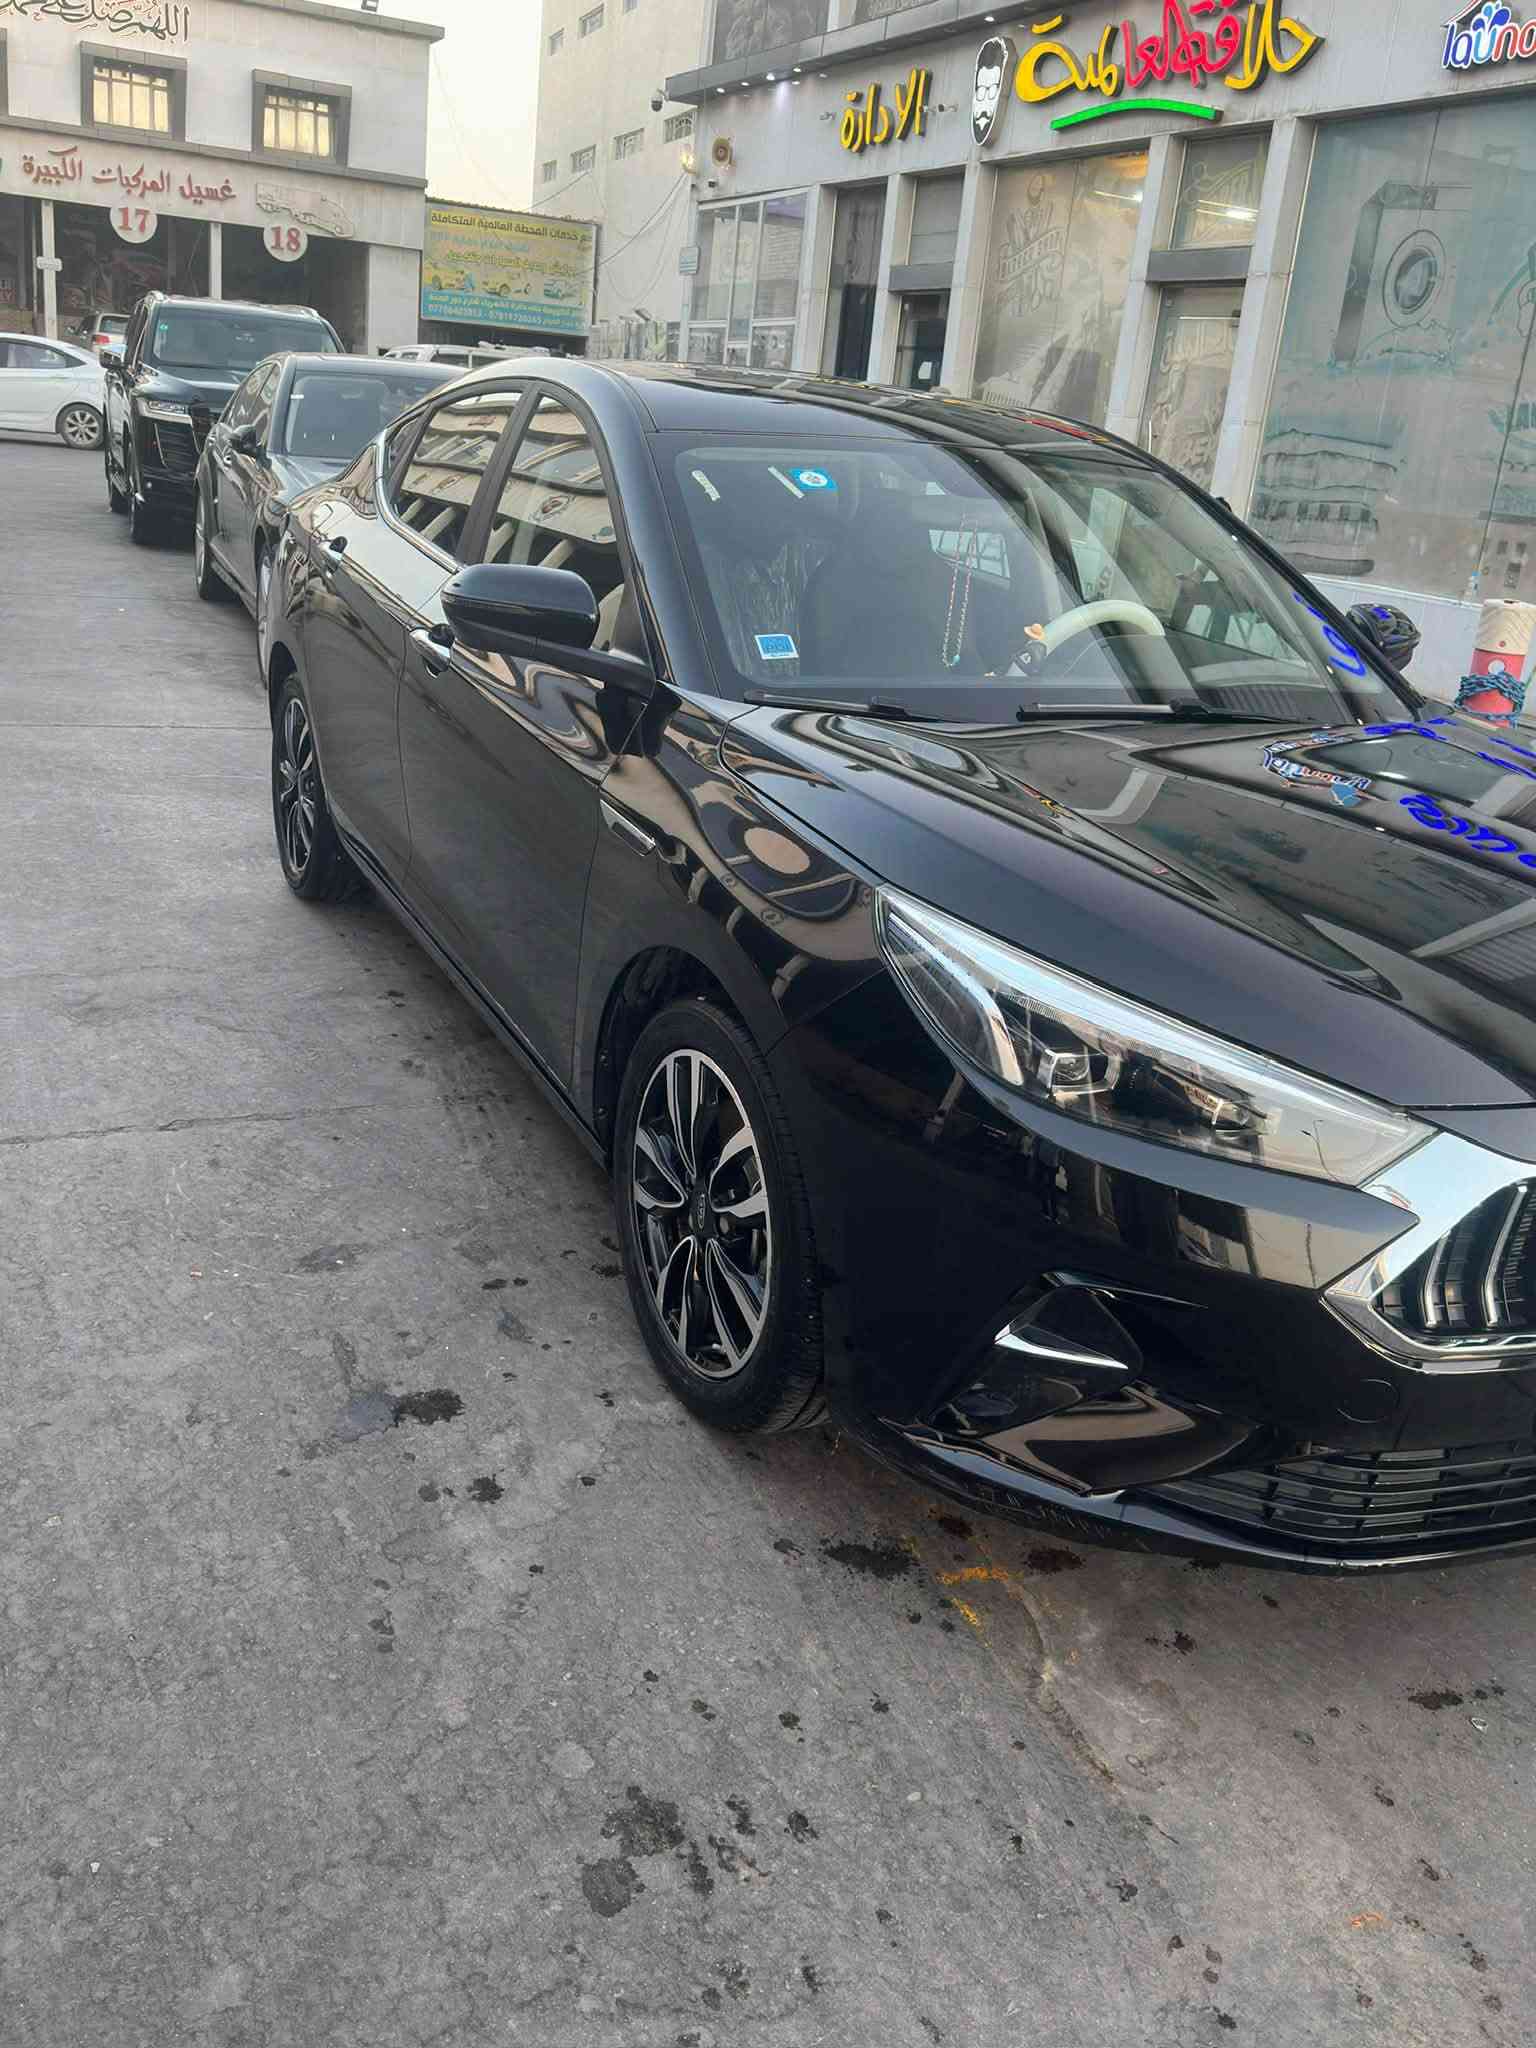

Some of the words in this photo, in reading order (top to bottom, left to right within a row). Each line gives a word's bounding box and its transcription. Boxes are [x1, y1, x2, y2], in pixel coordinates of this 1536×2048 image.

[21, 145, 83, 185] الكبيرة
[91, 164, 171, 198] المركبات
[178, 174, 237, 204] غسيل
[117, 206, 150, 234] 17
[270, 226, 302, 253] 18
